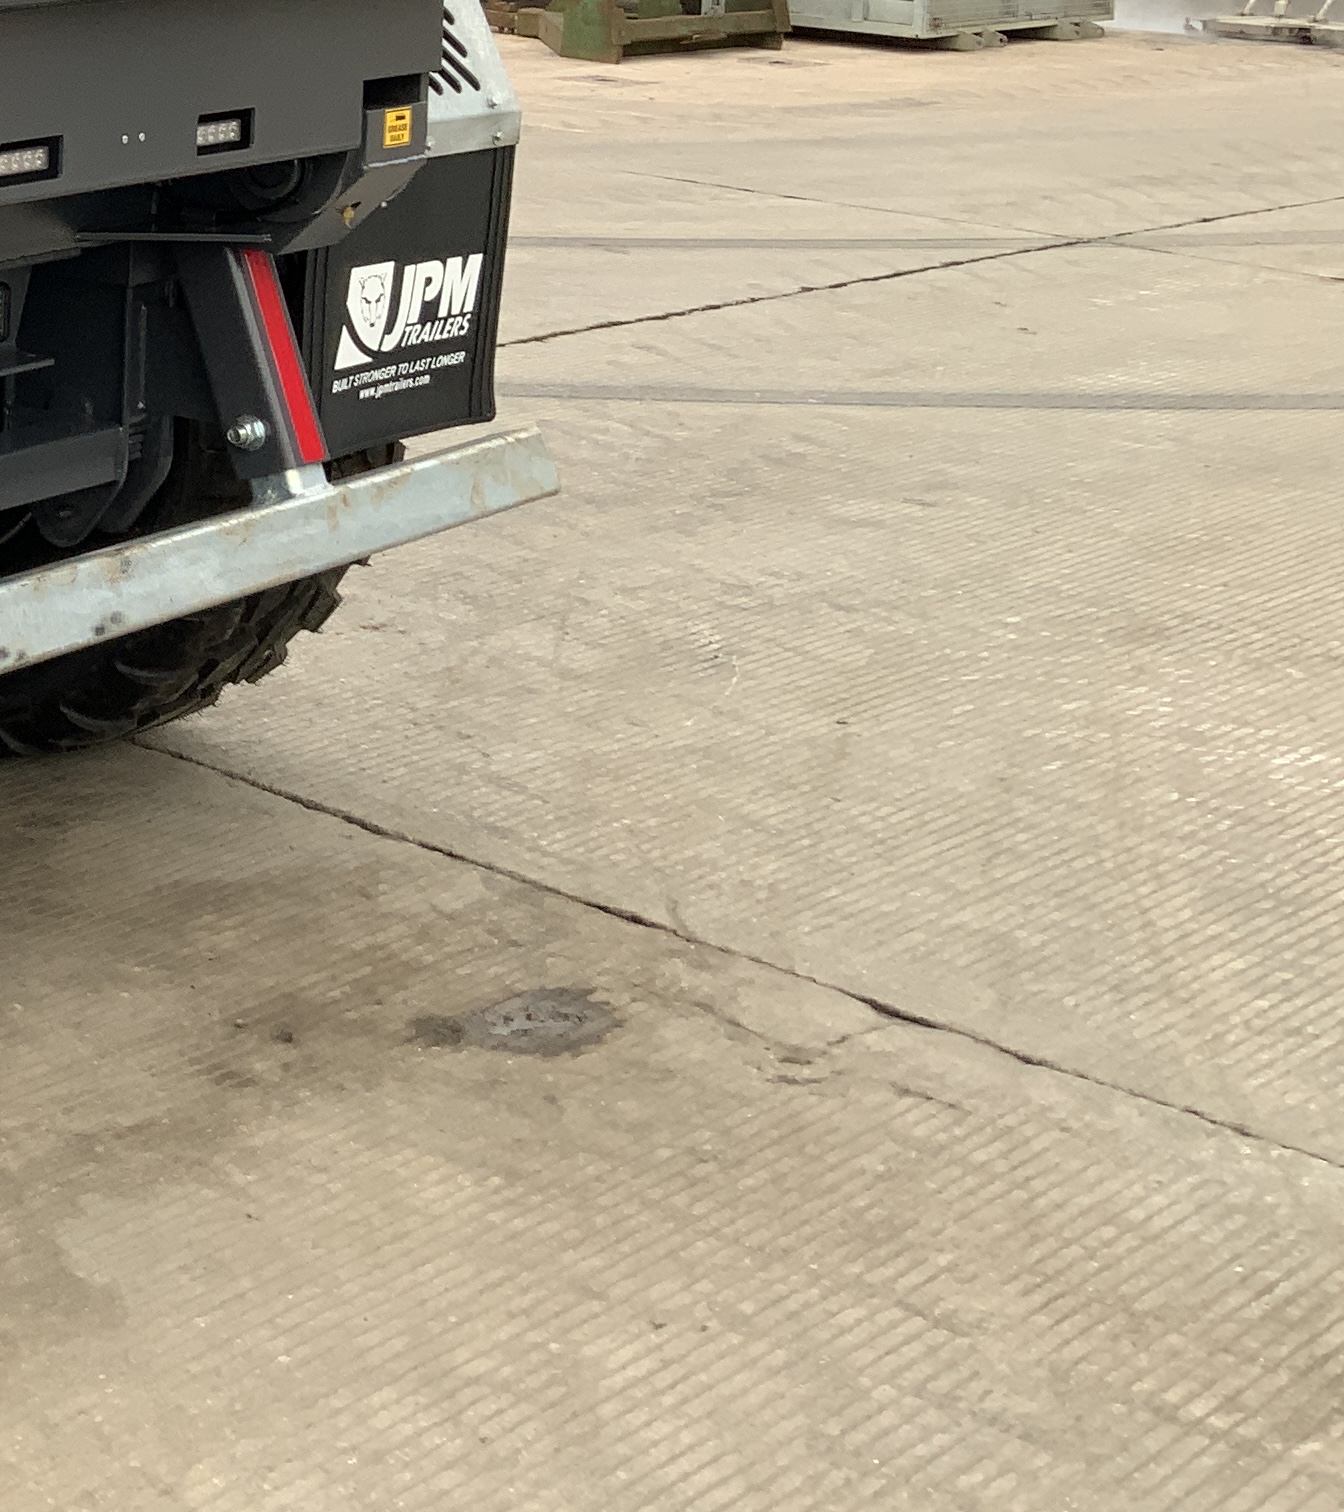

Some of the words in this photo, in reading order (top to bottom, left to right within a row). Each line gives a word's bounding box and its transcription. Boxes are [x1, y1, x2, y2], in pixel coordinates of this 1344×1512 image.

[380, 252, 484, 353] JPM
[400, 312, 472, 348] TRAILERS
[331, 376, 354, 394] BUILT
[353, 365, 397, 387] STRONGER
[397, 363, 409, 376] TO
[410, 357, 431, 373] LAST
[431, 351, 466, 368] LONGER
